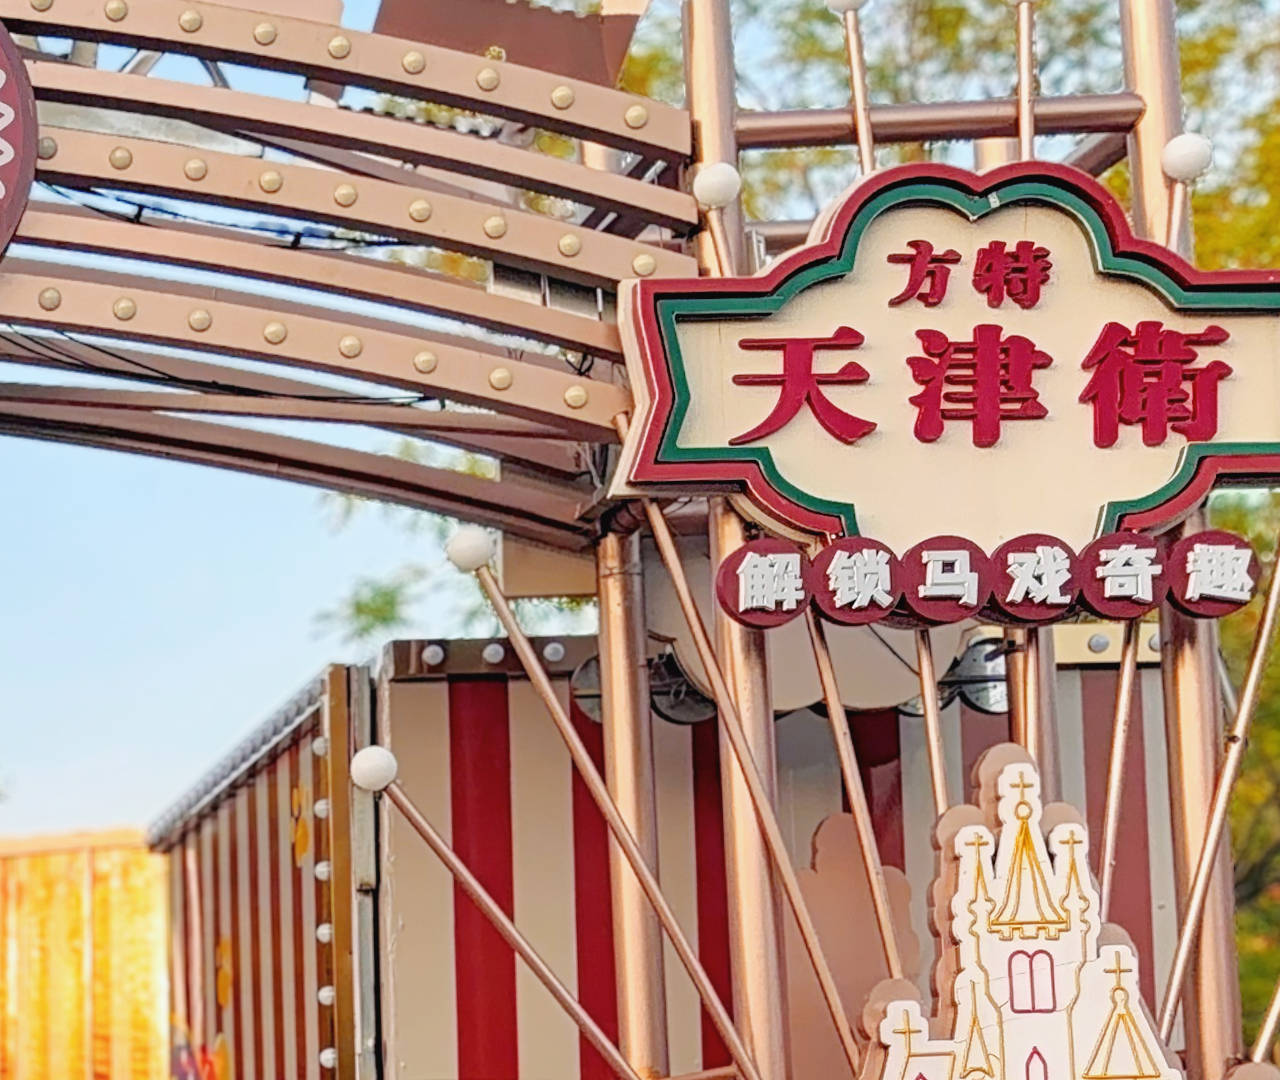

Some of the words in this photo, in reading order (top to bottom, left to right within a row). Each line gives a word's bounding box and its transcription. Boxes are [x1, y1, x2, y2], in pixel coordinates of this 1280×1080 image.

[888, 240, 1053, 309] 方特
[737, 545, 1253, 611] 解锁马戏奇趣
